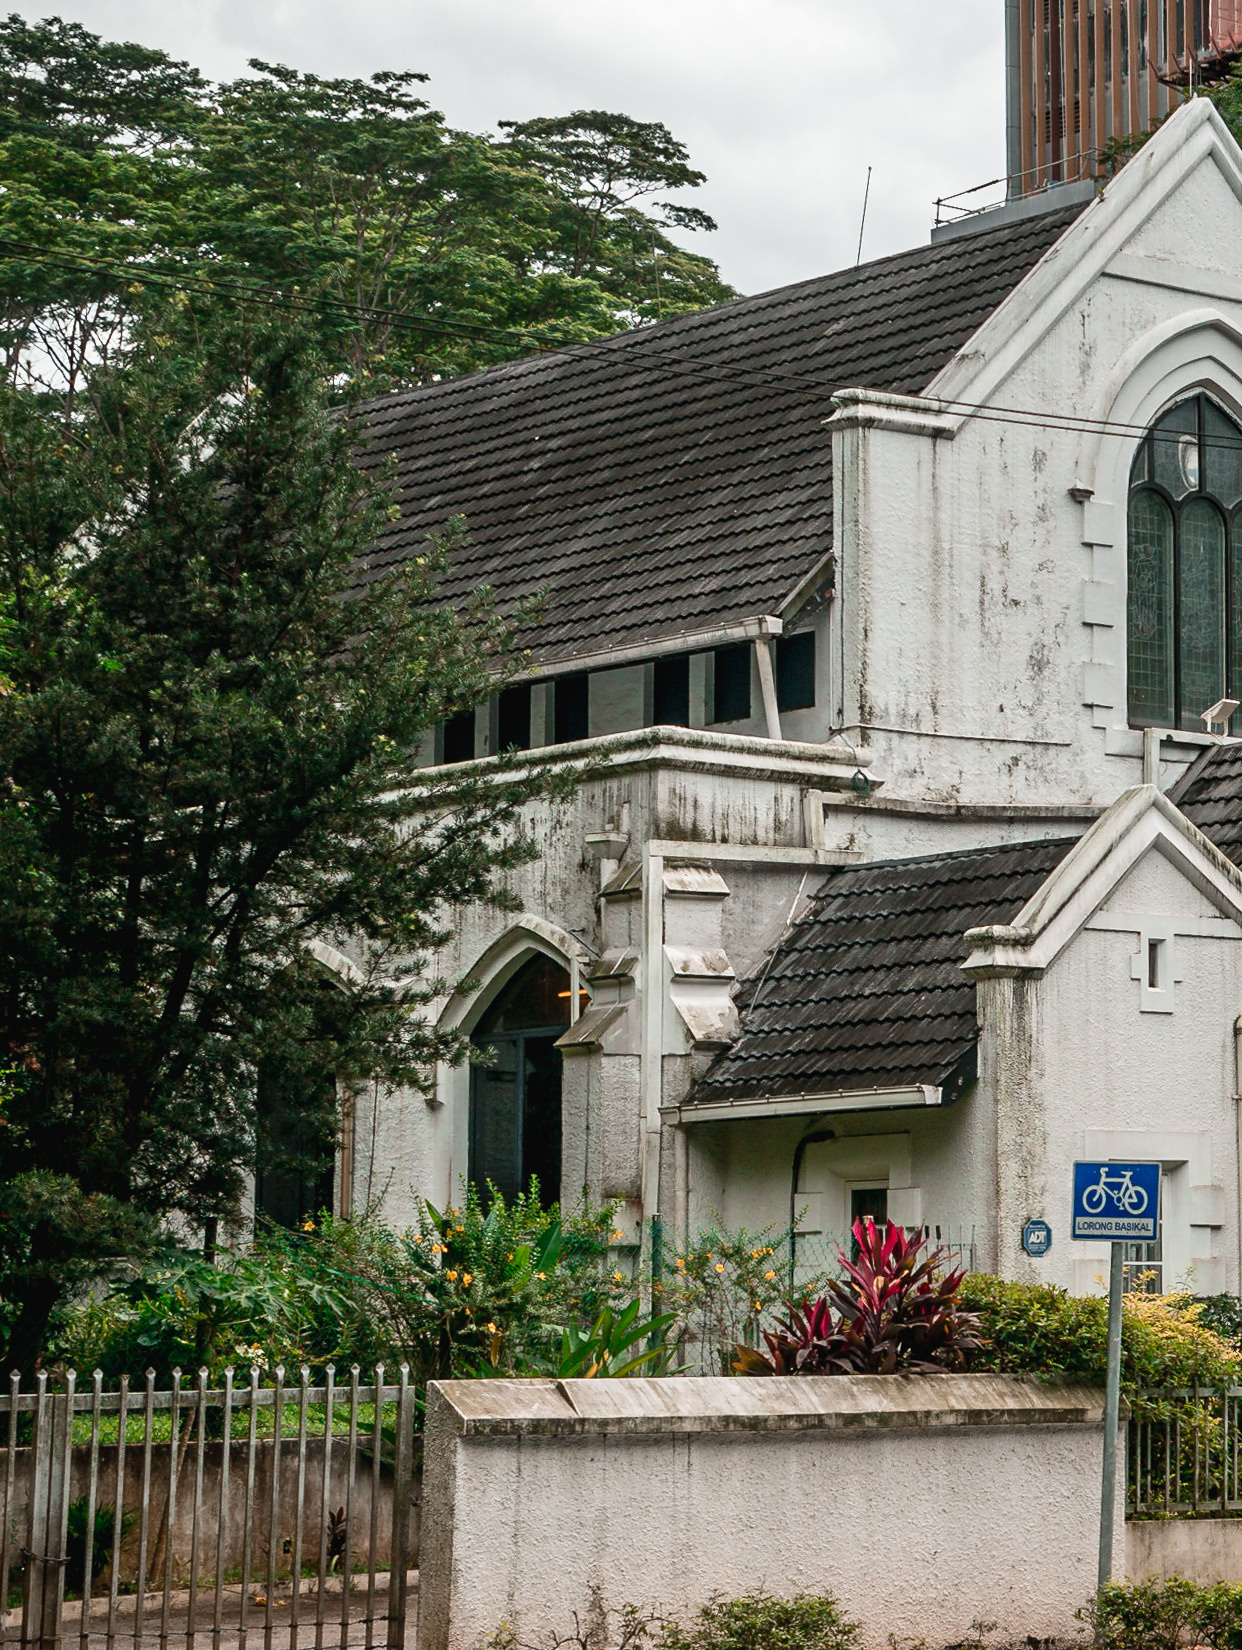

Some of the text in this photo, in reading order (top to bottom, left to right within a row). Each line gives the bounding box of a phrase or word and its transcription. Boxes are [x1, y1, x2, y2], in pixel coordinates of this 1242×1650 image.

[1077, 1221, 1151, 1232] LORONG BASIKAL
[1028, 1230, 1047, 1244] ADT
